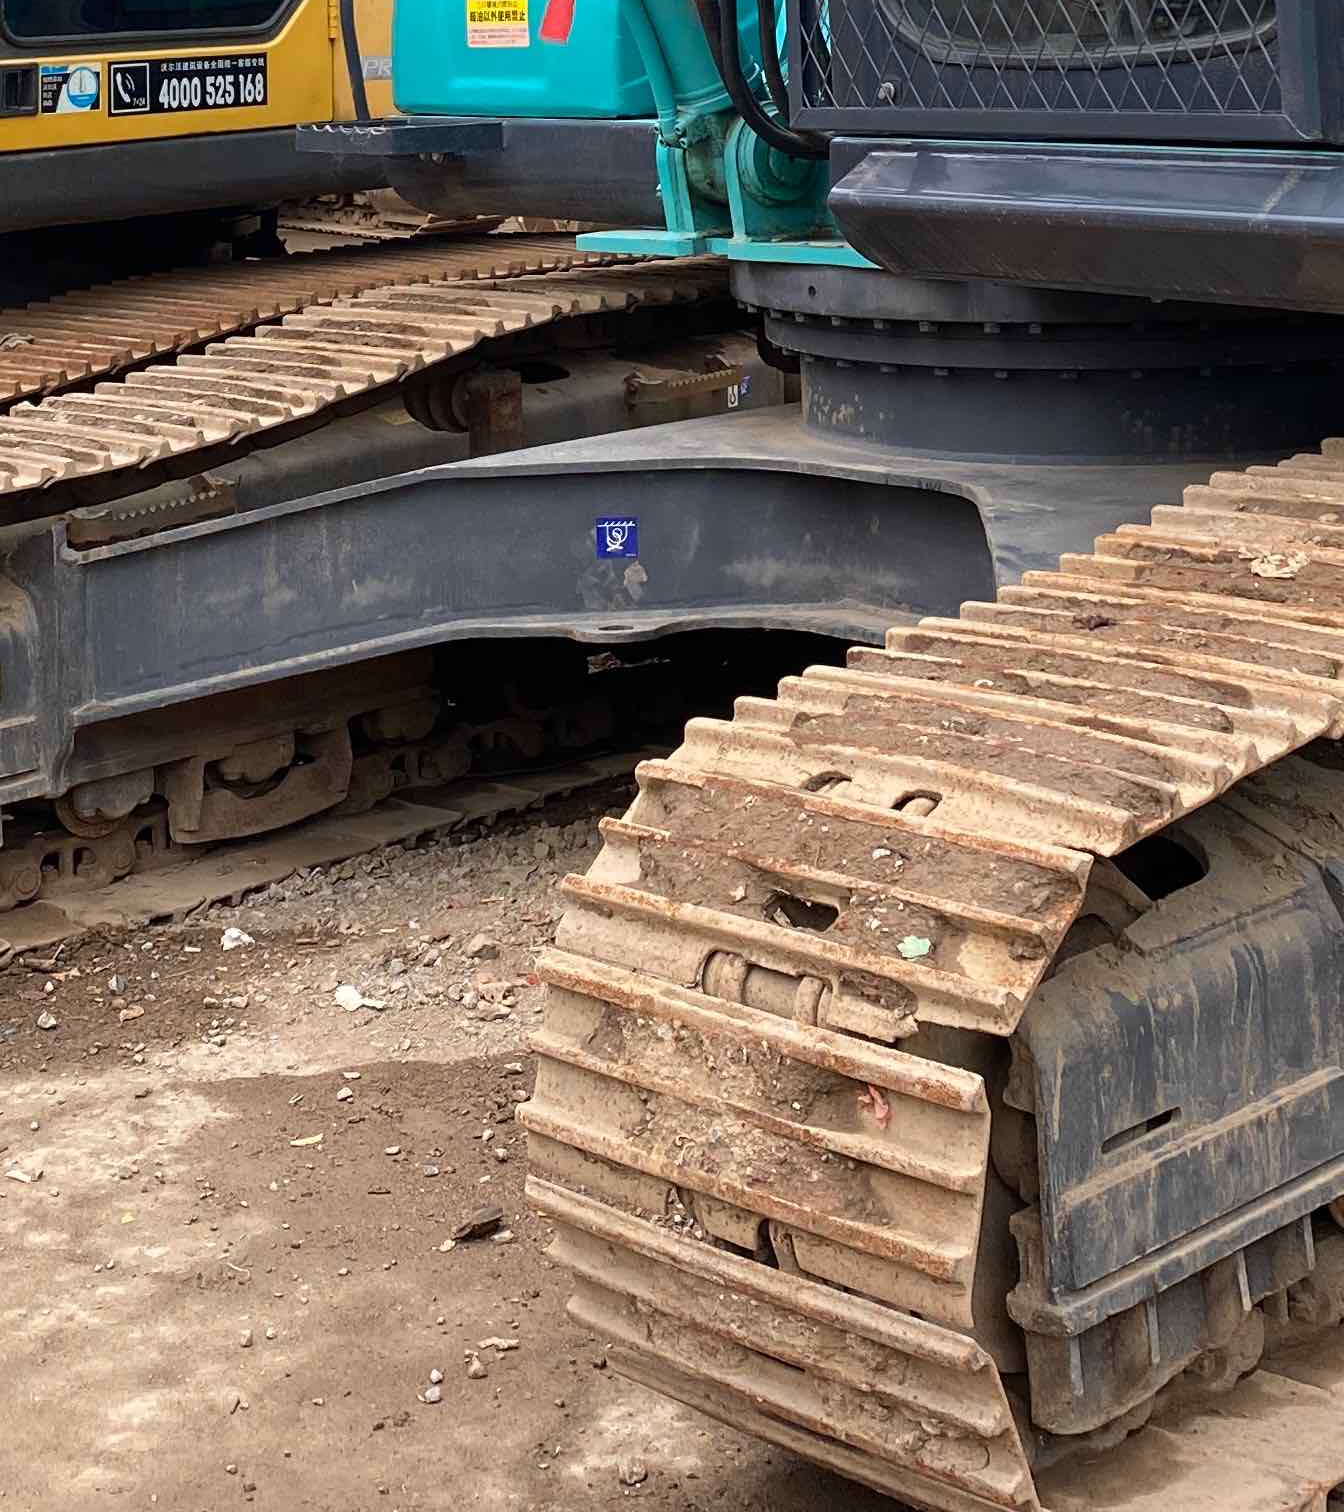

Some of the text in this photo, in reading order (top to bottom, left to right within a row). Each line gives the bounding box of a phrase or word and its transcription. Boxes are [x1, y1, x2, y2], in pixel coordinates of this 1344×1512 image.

[364, 58, 392, 77] PR
[159, 72, 264, 109] 4000 525 168
